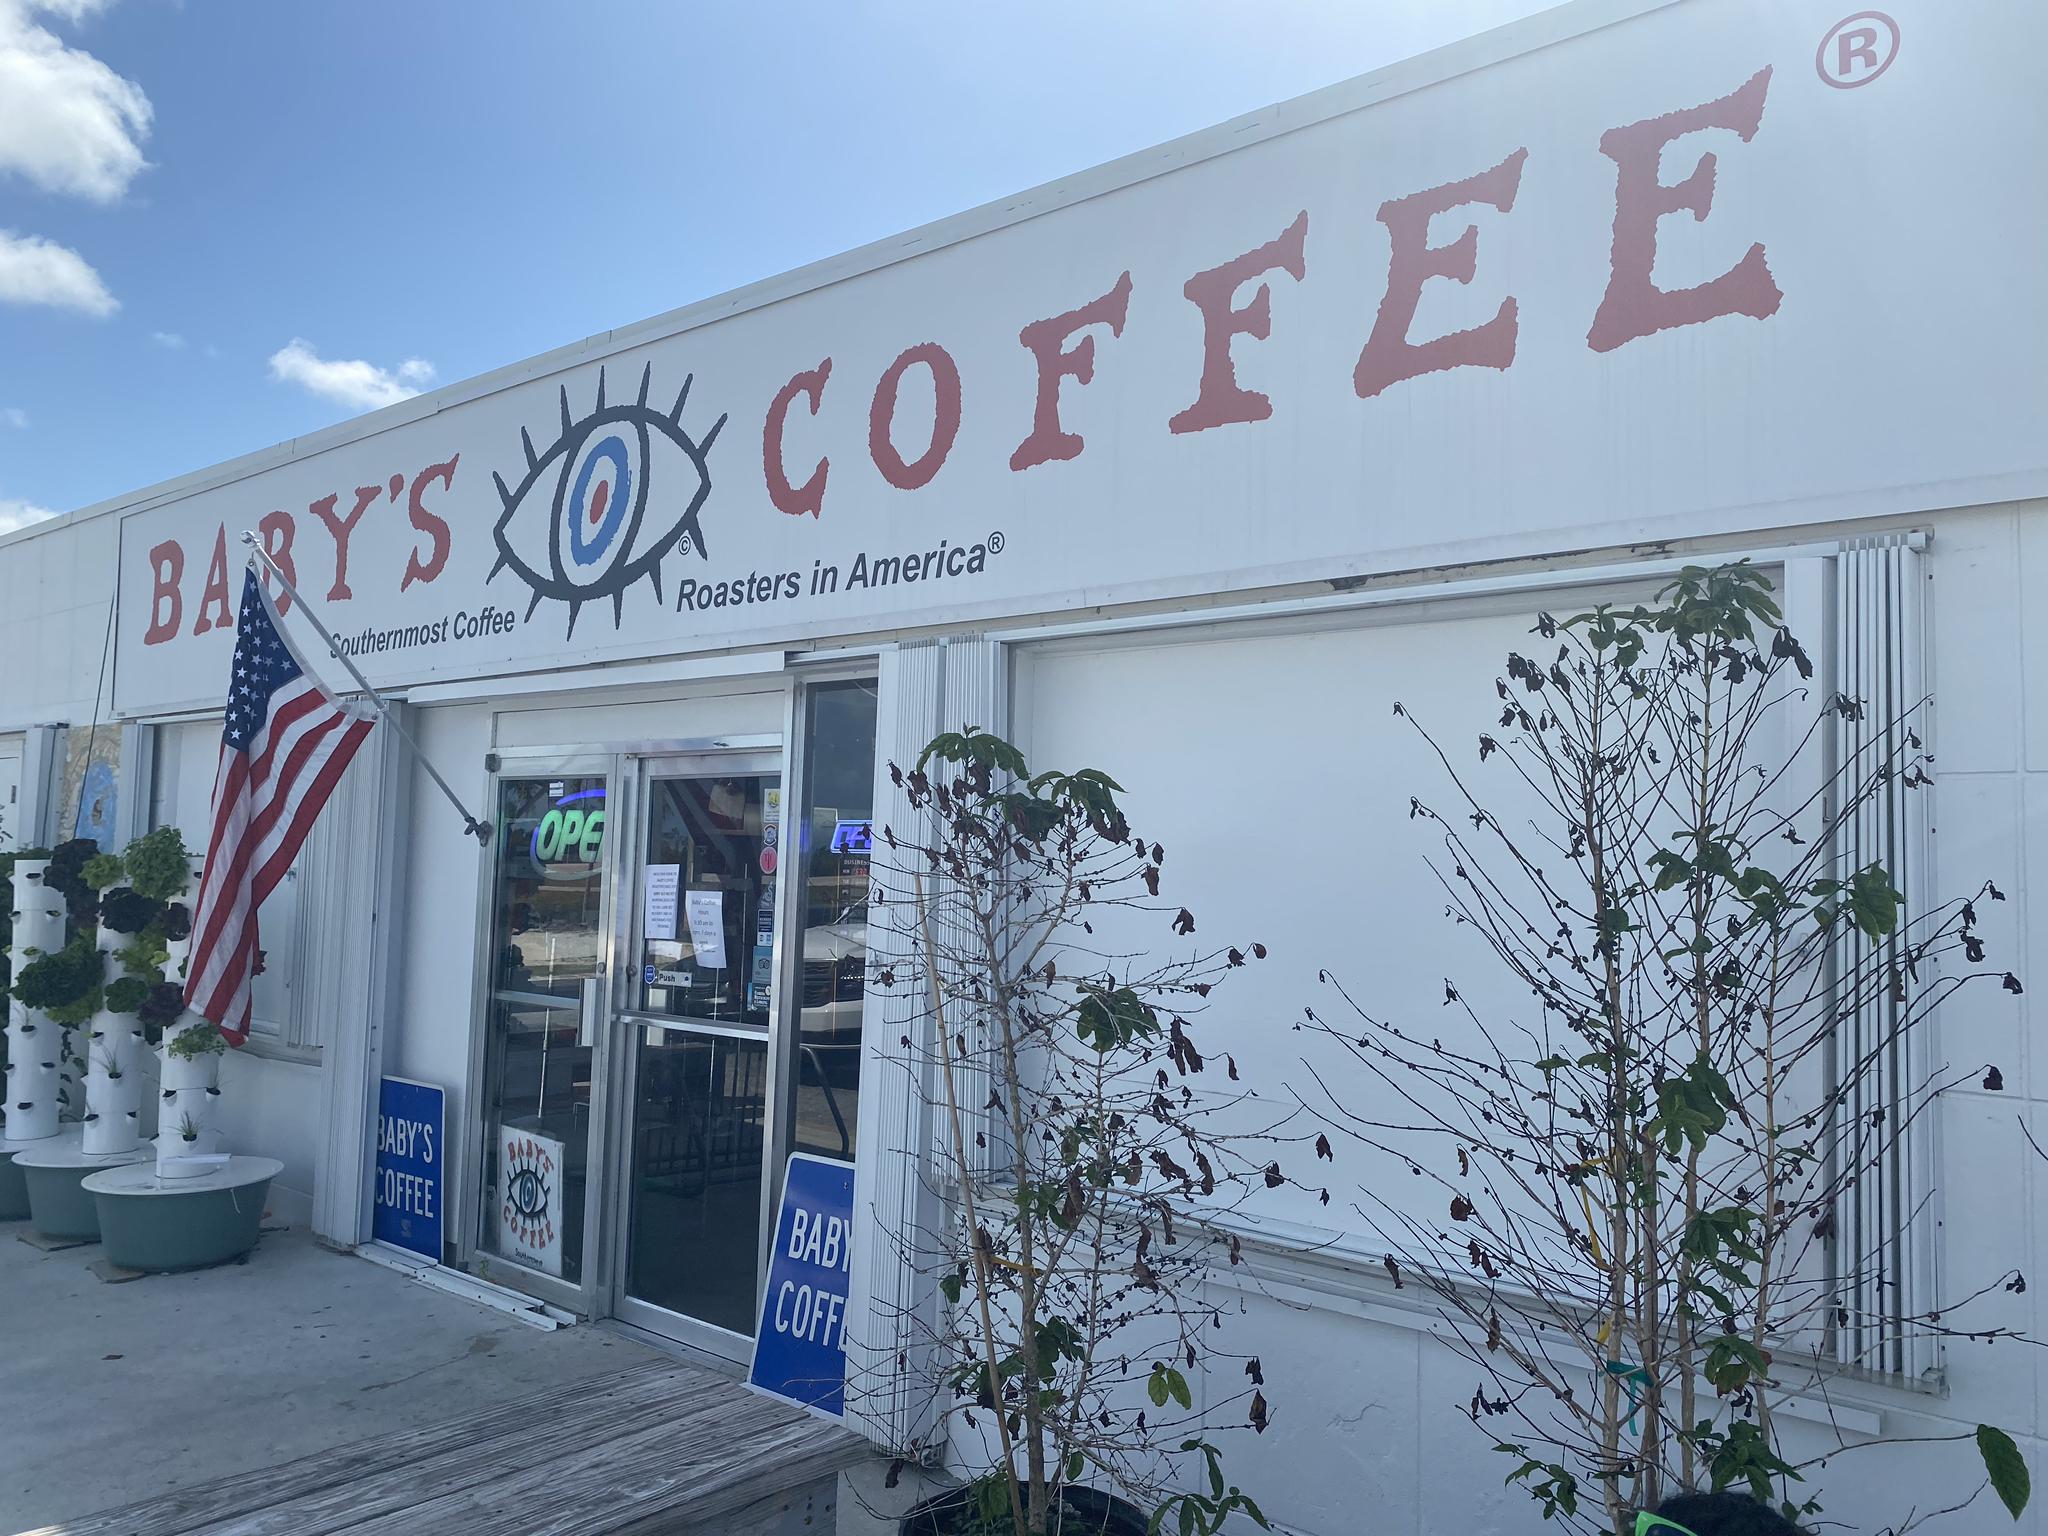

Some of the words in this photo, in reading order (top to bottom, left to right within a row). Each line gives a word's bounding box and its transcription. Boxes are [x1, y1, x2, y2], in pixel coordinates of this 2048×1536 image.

[762, 65, 1784, 519] COFFEE
[144, 452, 460, 646] BABY'S
[676, 569, 801, 613] Roasters
[810, 559, 839, 596] in
[453, 606, 516, 640] Coffee
[536, 809, 606, 863] OPE
[659, 973, 676, 982] Push
[503, 1205, 554, 1250] COFFEE
